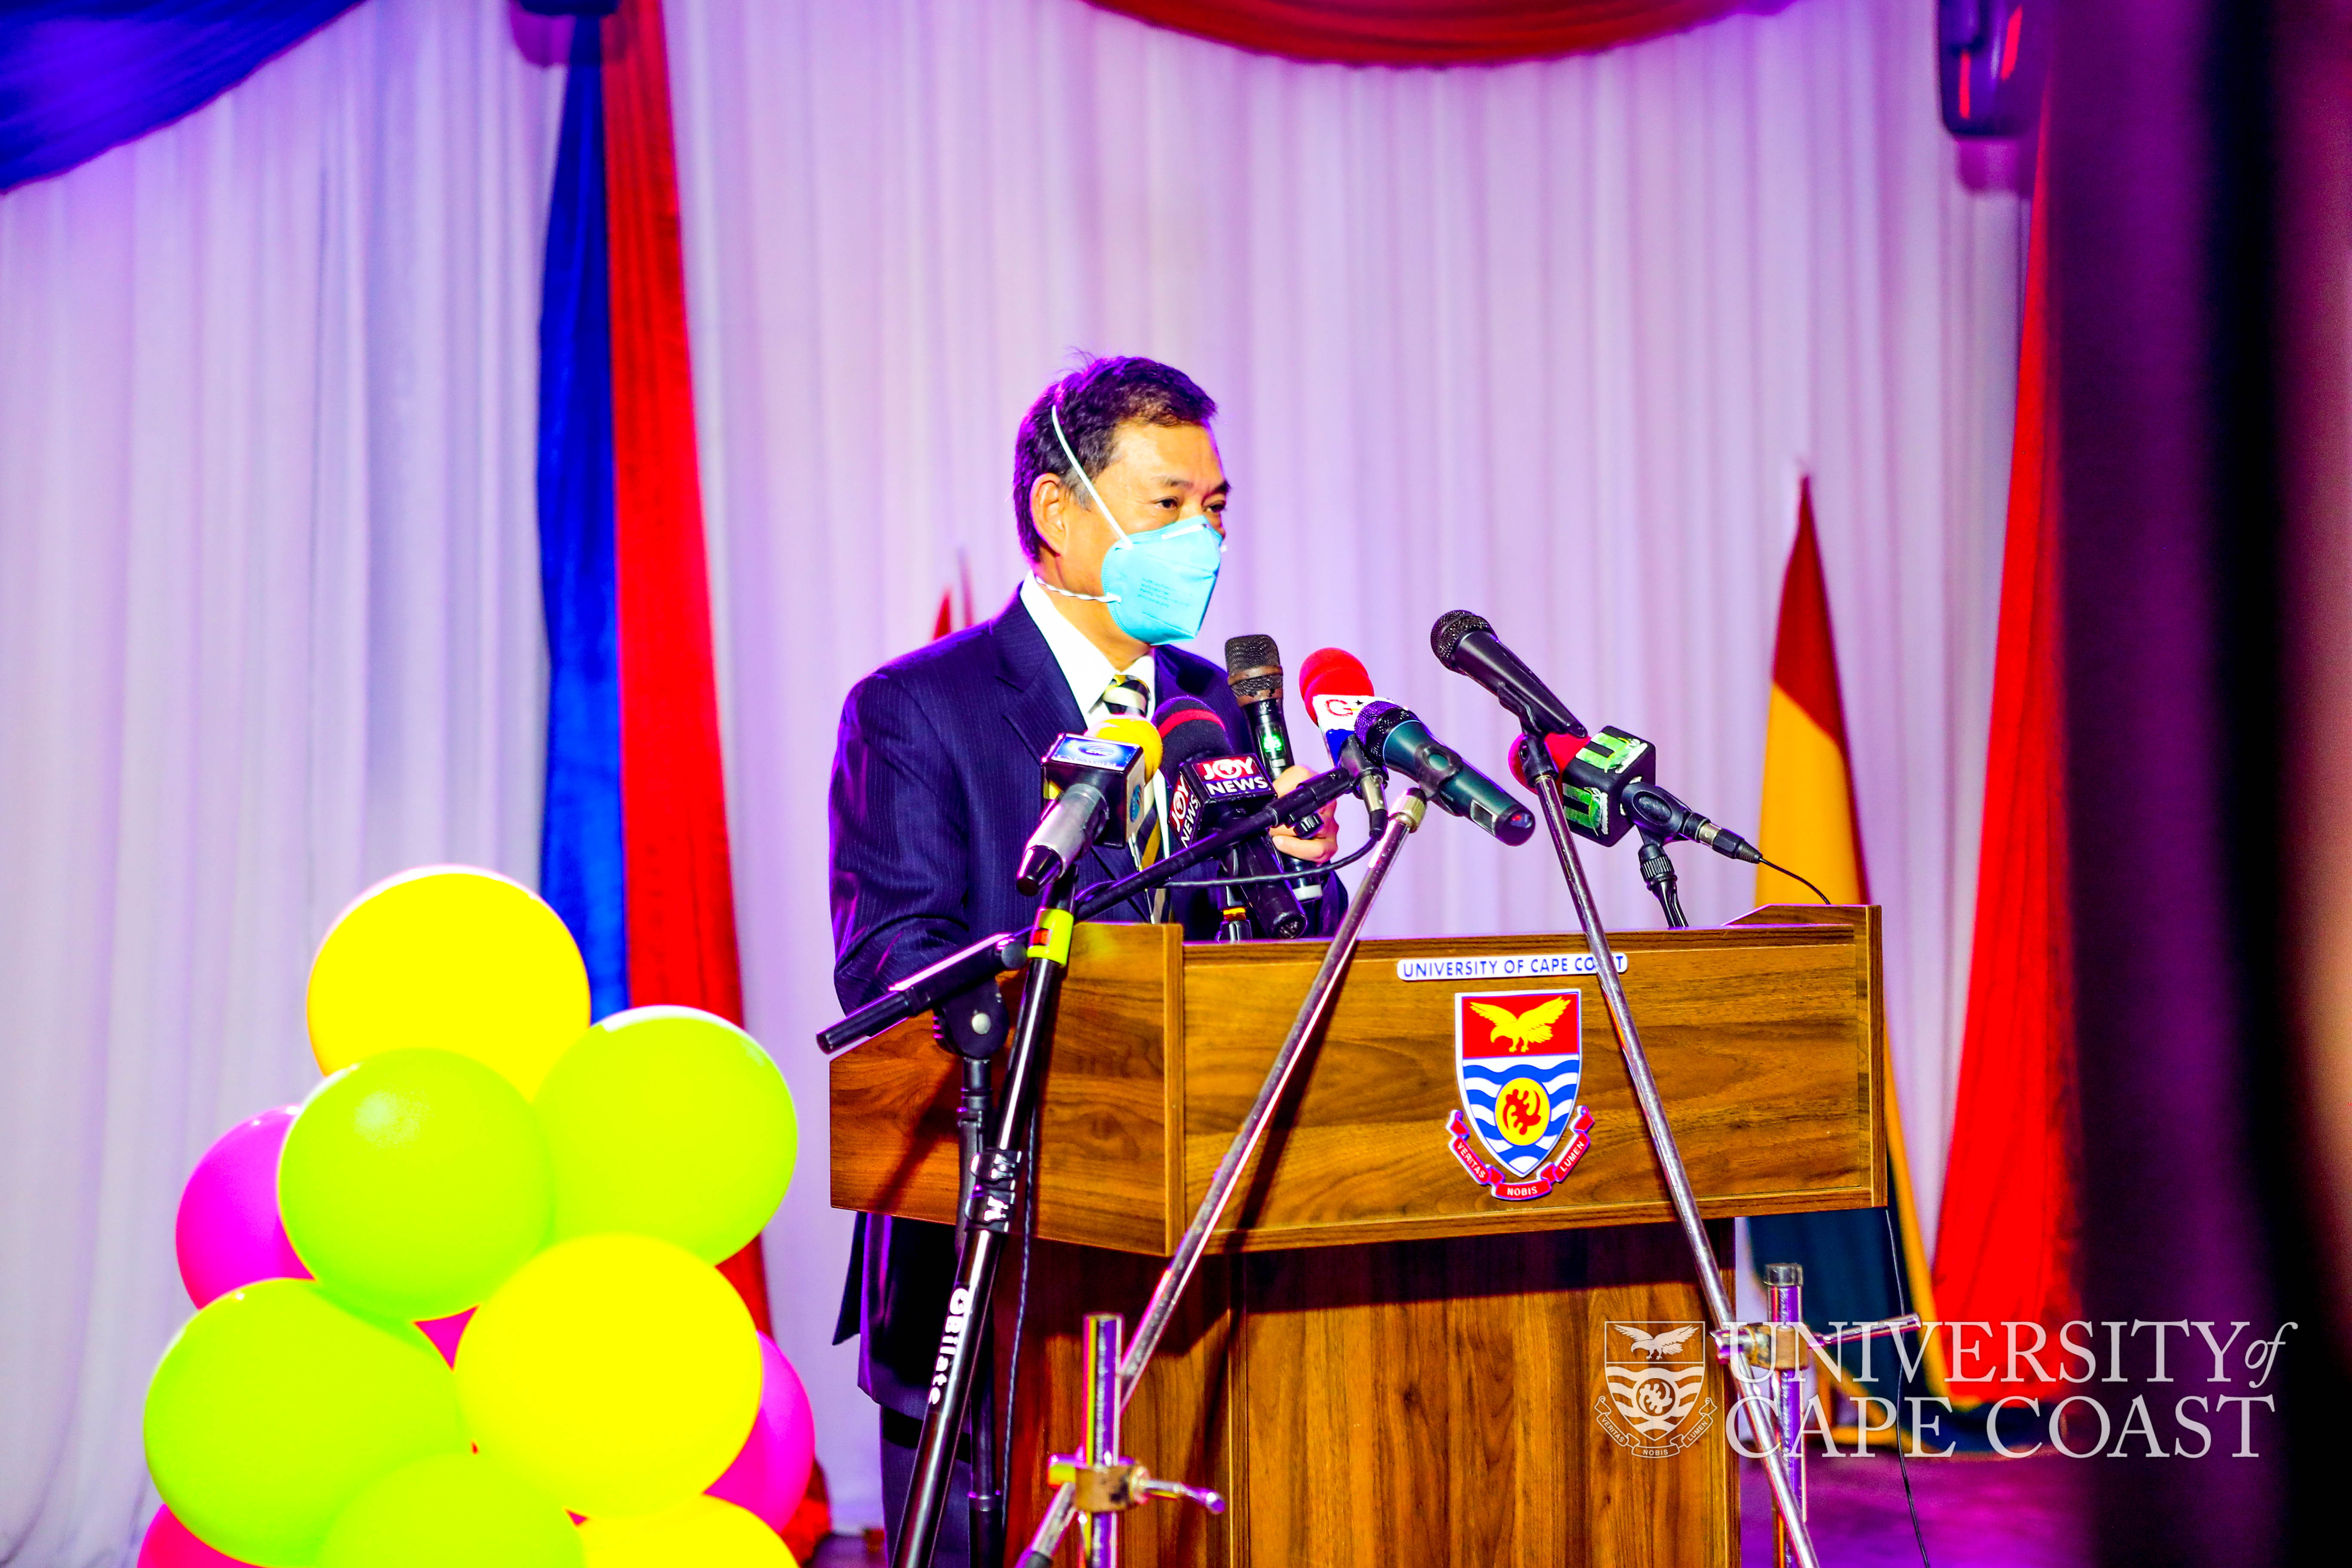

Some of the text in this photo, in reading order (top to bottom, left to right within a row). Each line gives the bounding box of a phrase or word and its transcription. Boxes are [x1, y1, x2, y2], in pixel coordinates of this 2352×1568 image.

[1202, 756, 1254, 780] JOY
[1205, 776, 1268, 795] NEWS
[1171, 774, 1189, 833] JOY
[1180, 793, 1198, 849] NEWS
[1403, 956, 1623, 977] UNIVERSITY OF CAPE COT
[1458, 1141, 1486, 1179] VERITAS
[1559, 1140, 1585, 1172] LUMEN
[1507, 1186, 1538, 1196] NOBIS
